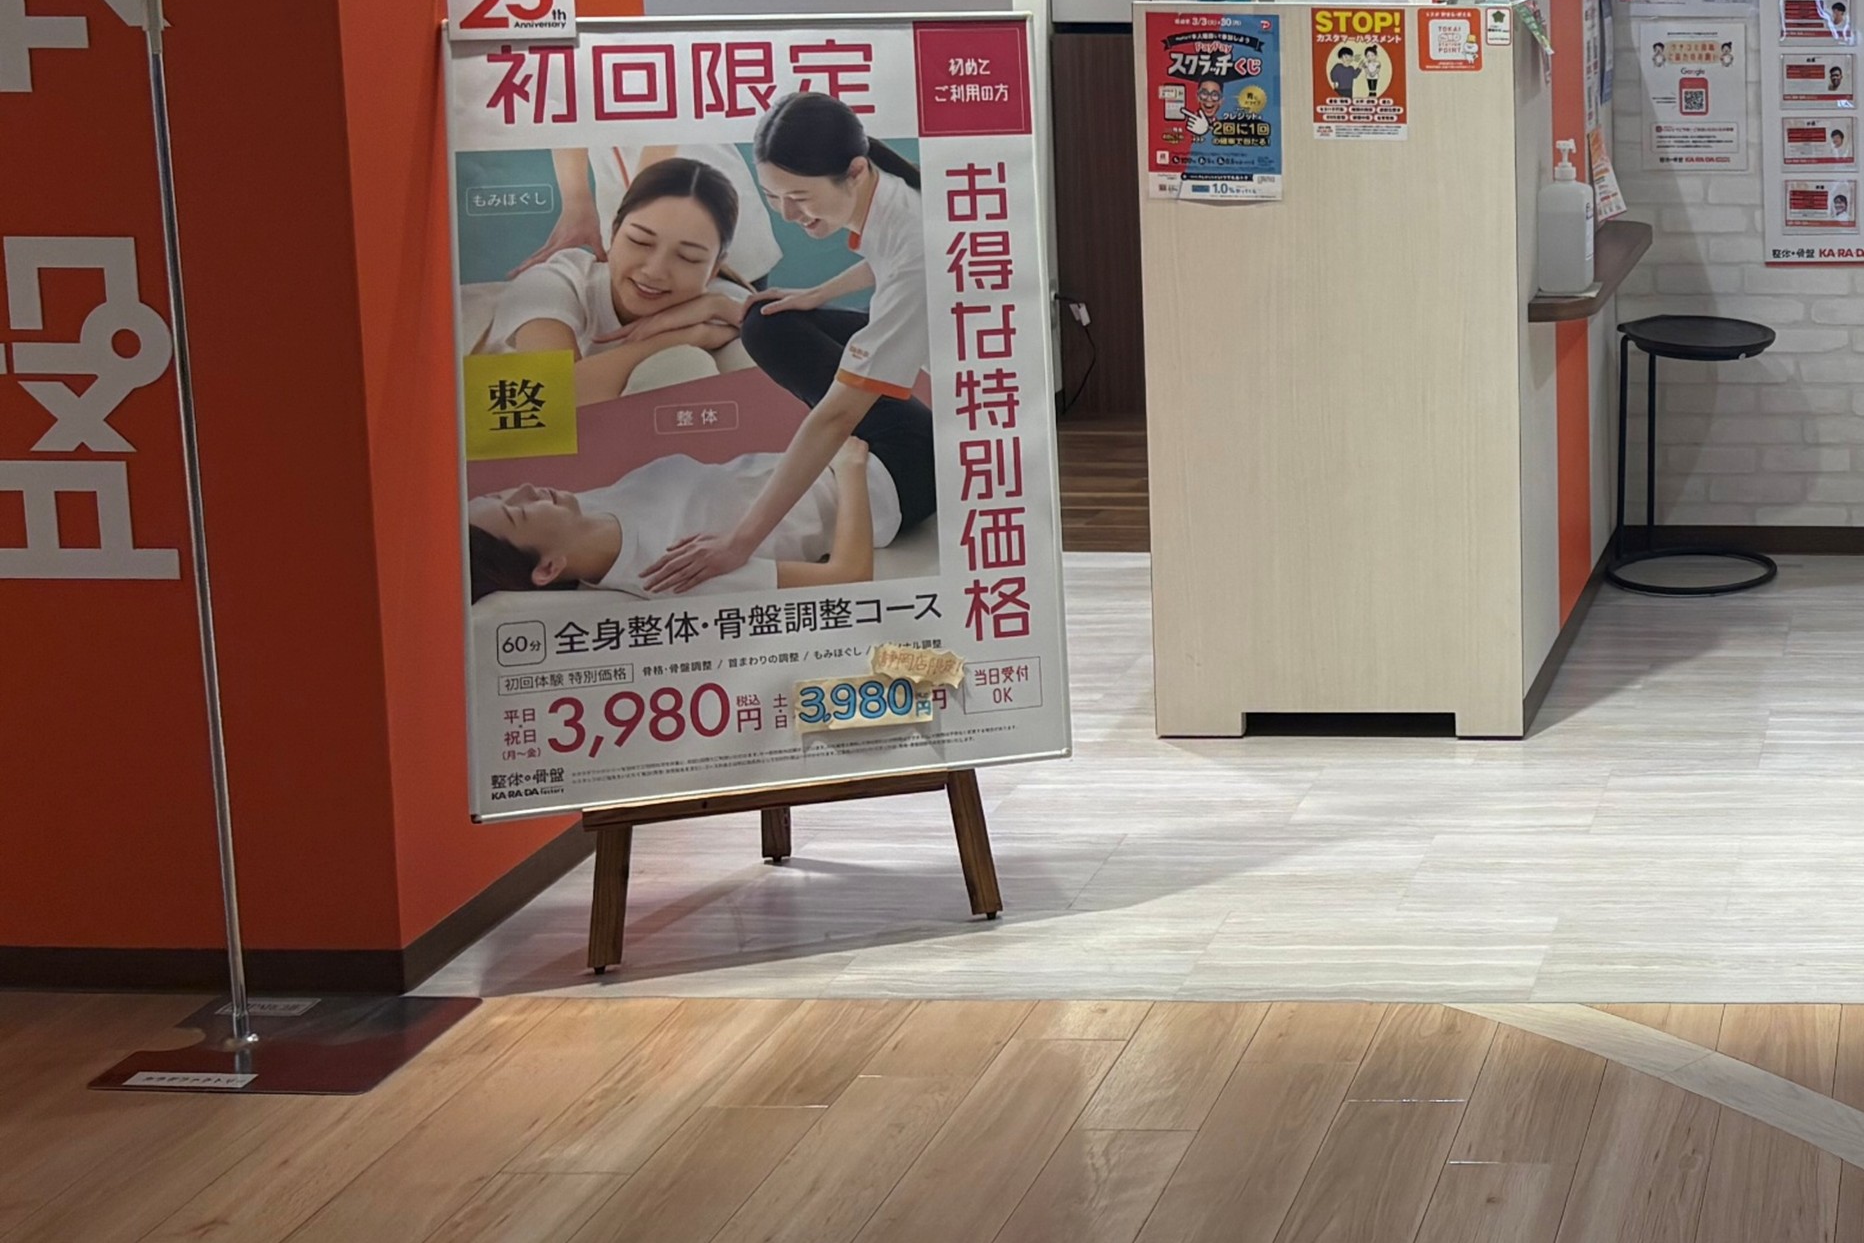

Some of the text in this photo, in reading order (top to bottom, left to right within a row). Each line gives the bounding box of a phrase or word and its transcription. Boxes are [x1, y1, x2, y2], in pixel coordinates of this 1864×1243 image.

[514, 21, 566, 29] Anniversary
[1315, 11, 1401, 33] STOP!
[1317, 34, 1401, 43] カスタマーハラスメント
[948, 57, 990, 76] 初めて
[1168, 53, 1261, 75] スクラッチくじ
[1681, 67, 1705, 75] Google
[487, 39, 875, 124] 初回限定
[934, 83, 1009, 103] ご利用の方
[472, 191, 547, 208] もみほぐし
[488, 378, 546, 431] 整
[945, 162, 1030, 641] お得な特別価格
[676, 407, 718, 427] 整体
[554, 593, 942, 655] 全身整体・骨盤調整コース
[502, 636, 541, 653] 60分
[728, 652, 799, 670] 首まわりの調整
[814, 645, 861, 660] もみほぐし
[505, 667, 626, 691] 初回体験 特別価格
[974, 665, 1028, 686] 当日受付
[737, 694, 760, 706] 税込
[993, 687, 1013, 704] OK
[505, 708, 536, 724] 平日
[505, 730, 536, 746] 祝日
